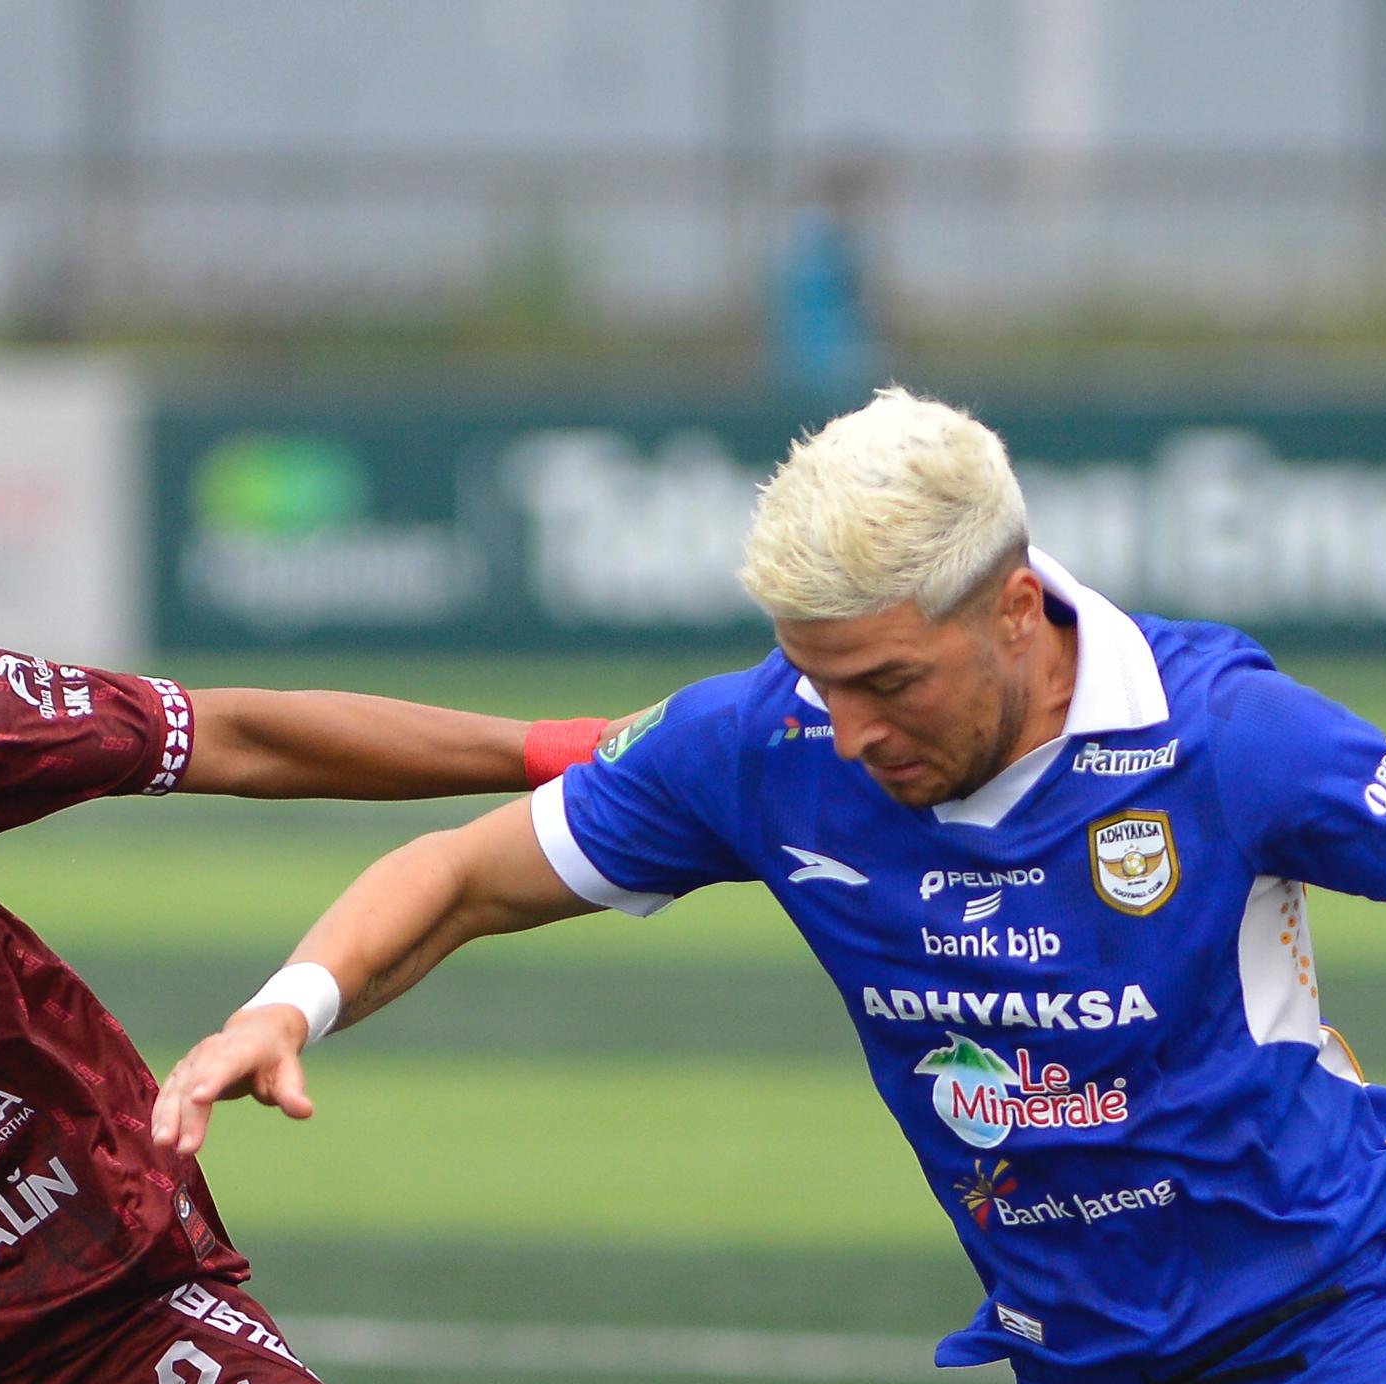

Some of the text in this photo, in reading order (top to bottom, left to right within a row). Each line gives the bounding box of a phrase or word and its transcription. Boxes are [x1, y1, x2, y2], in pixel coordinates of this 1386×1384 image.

[804, 725, 834, 738] PERTA
[1073, 738, 1180, 776] Farmel
[1099, 822, 1161, 845] ADHYAKSA
[948, 867, 1045, 888] PELINDO
[921, 927, 1061, 963] bank bjb
[863, 984, 1158, 1030] ADHYAKSA
[1016, 1048, 1070, 1094] Le
[993, 1179, 1177, 1226] Bank Jateng
